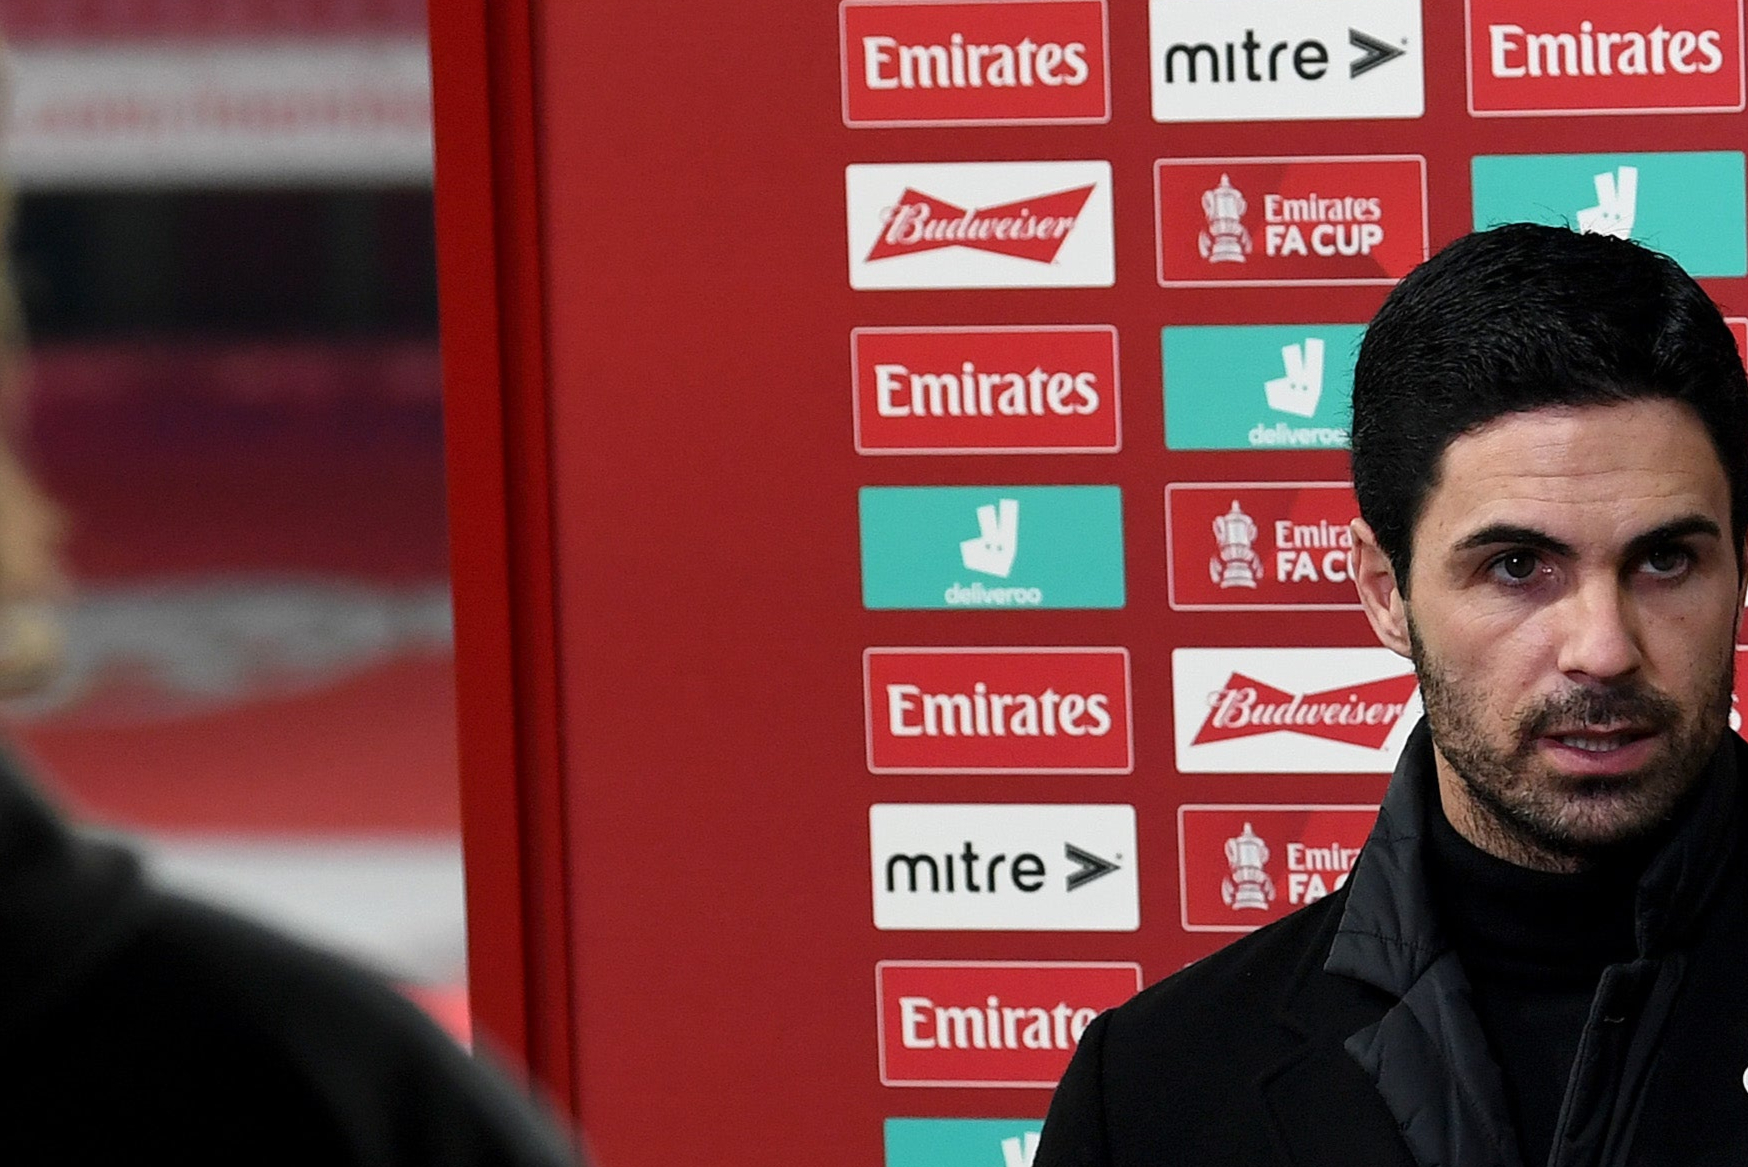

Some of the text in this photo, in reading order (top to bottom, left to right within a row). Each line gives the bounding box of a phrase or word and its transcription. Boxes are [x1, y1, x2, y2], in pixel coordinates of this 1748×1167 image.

[863, 33, 1089, 89] Emirates
[1165, 30, 1329, 84] mitre
[1489, 21, 1723, 78] Emirates
[878, 200, 1078, 246] Budweiser
[1264, 193, 1382, 223] Emirates
[1265, 223, 1384, 256] FA CUP
[875, 362, 1099, 417] Emirates
[1275, 519, 1353, 549] Emira
[1276, 551, 1318, 582] FA
[944, 583, 1042, 605] deliveroo
[887, 682, 1111, 736] Emirates
[1207, 686, 1404, 729] Budweiser
[886, 841, 1046, 893] mitre
[1287, 843, 1361, 871] Emir
[1288, 873, 1328, 904] FA
